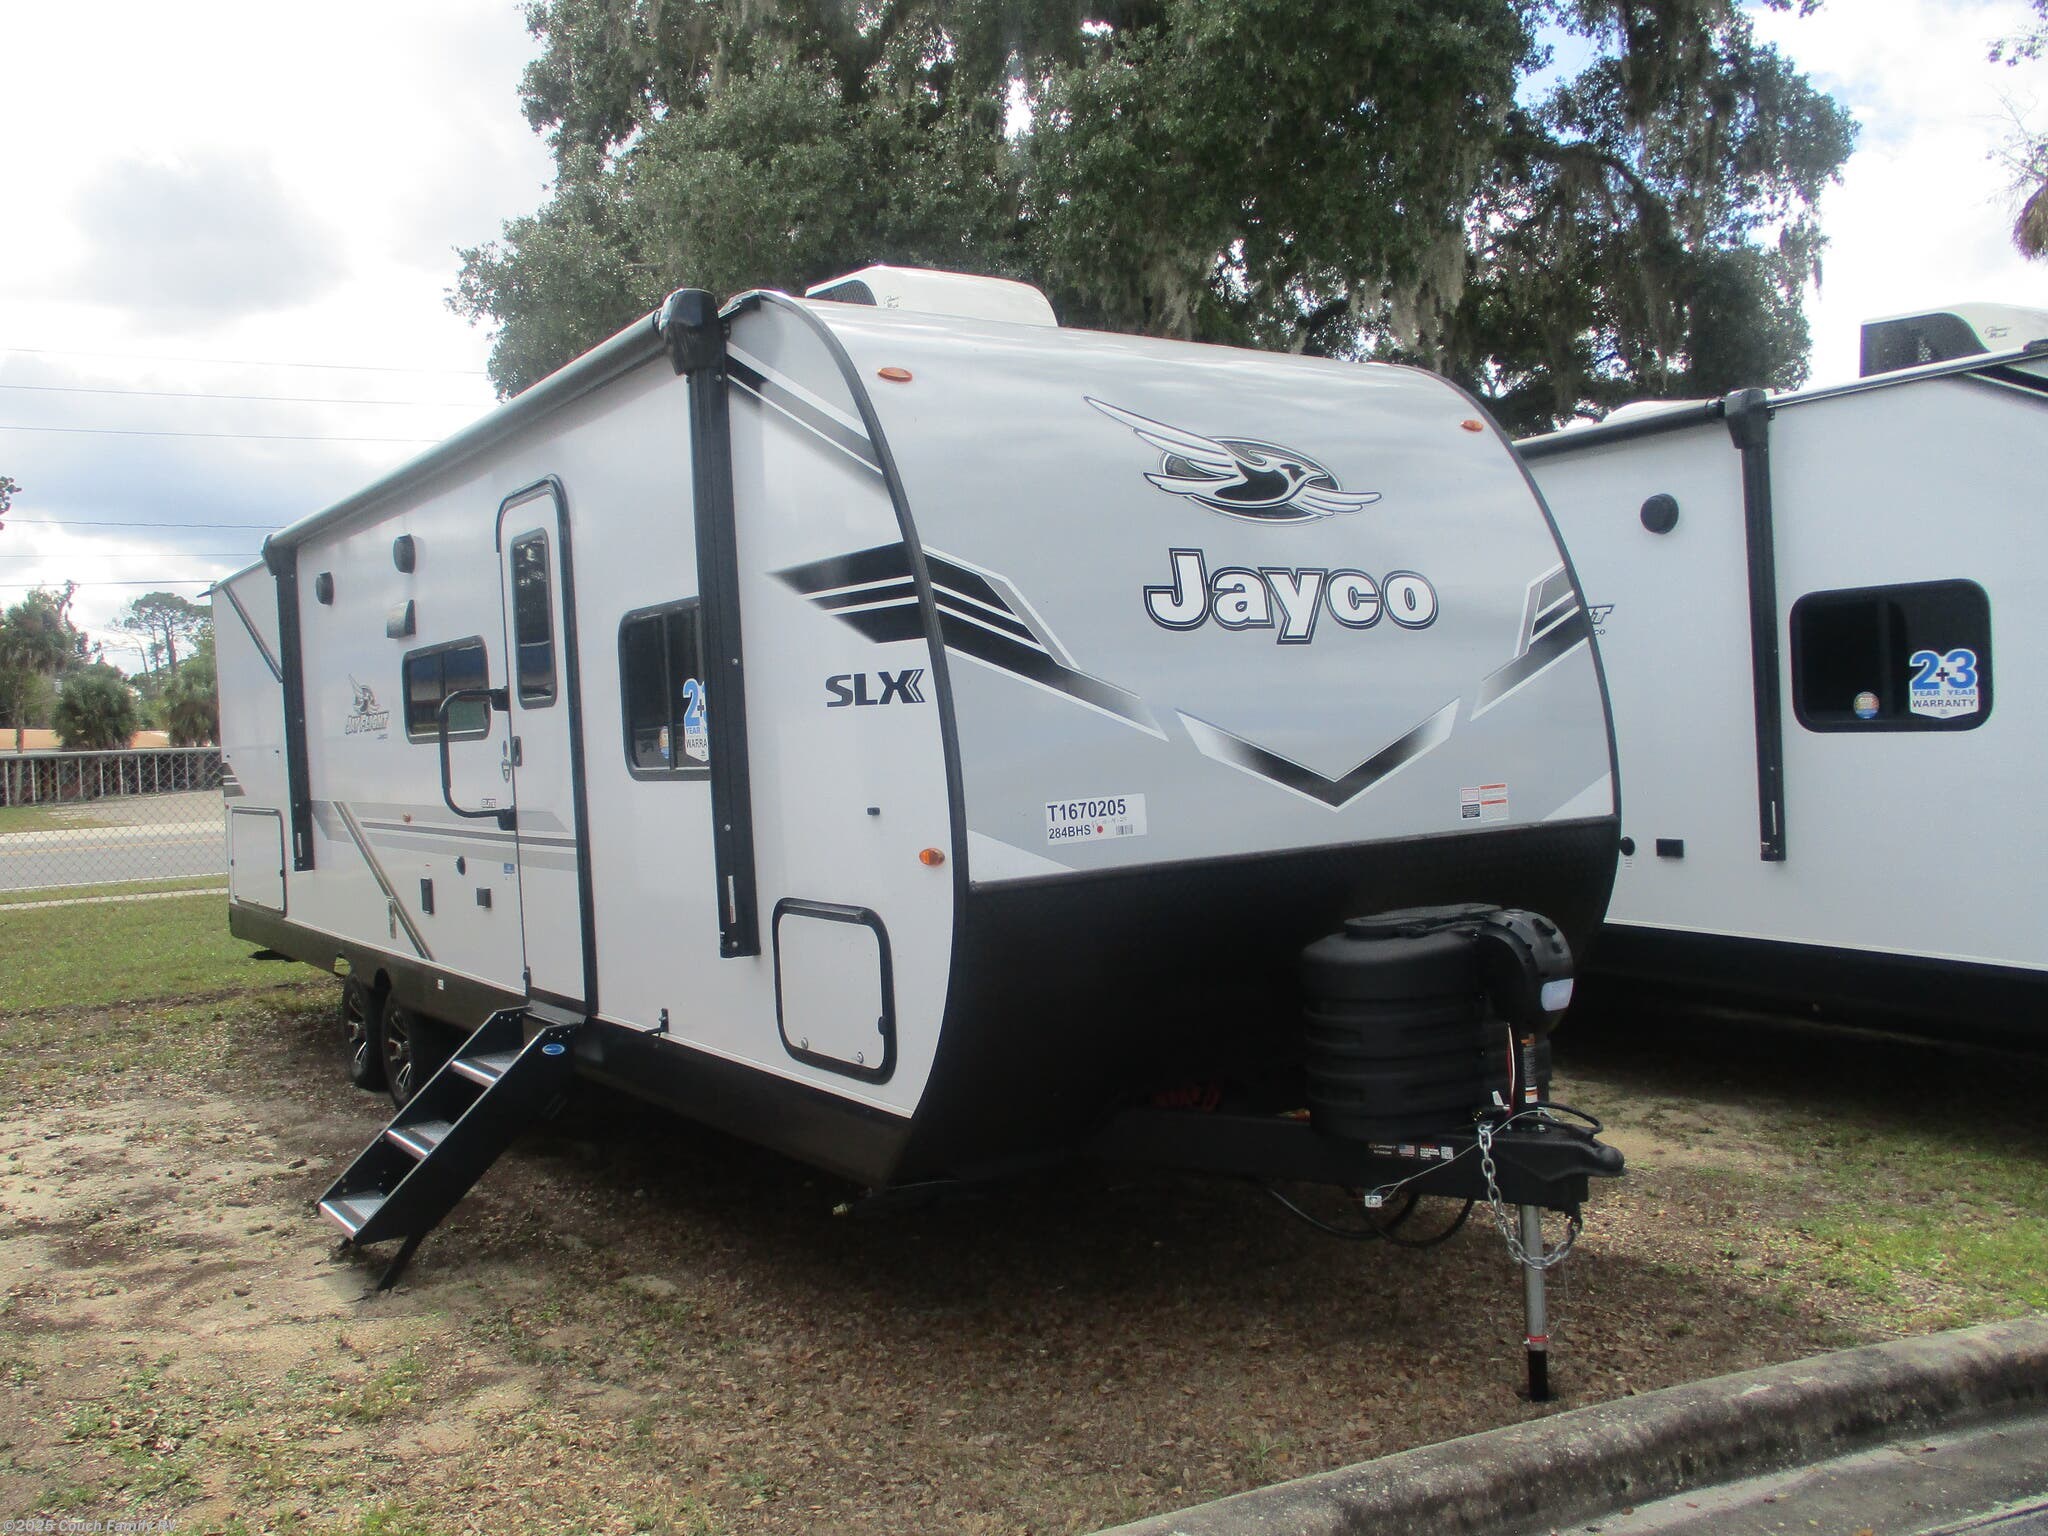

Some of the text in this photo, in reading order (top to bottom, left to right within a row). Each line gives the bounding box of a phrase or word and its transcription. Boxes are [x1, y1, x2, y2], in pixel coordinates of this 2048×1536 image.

[1143, 547, 1439, 645] Jayco
[825, 669, 925, 707] SLX
[1912, 688, 1976, 697] YEAR YEAR
[1912, 699, 1976, 708] WARRANTY
[686, 726, 701, 735] YEAR
[686, 738, 708, 749] WARRA
[1047, 799, 1126, 822] T1670205
[1048, 824, 1092, 839] 284BHS
